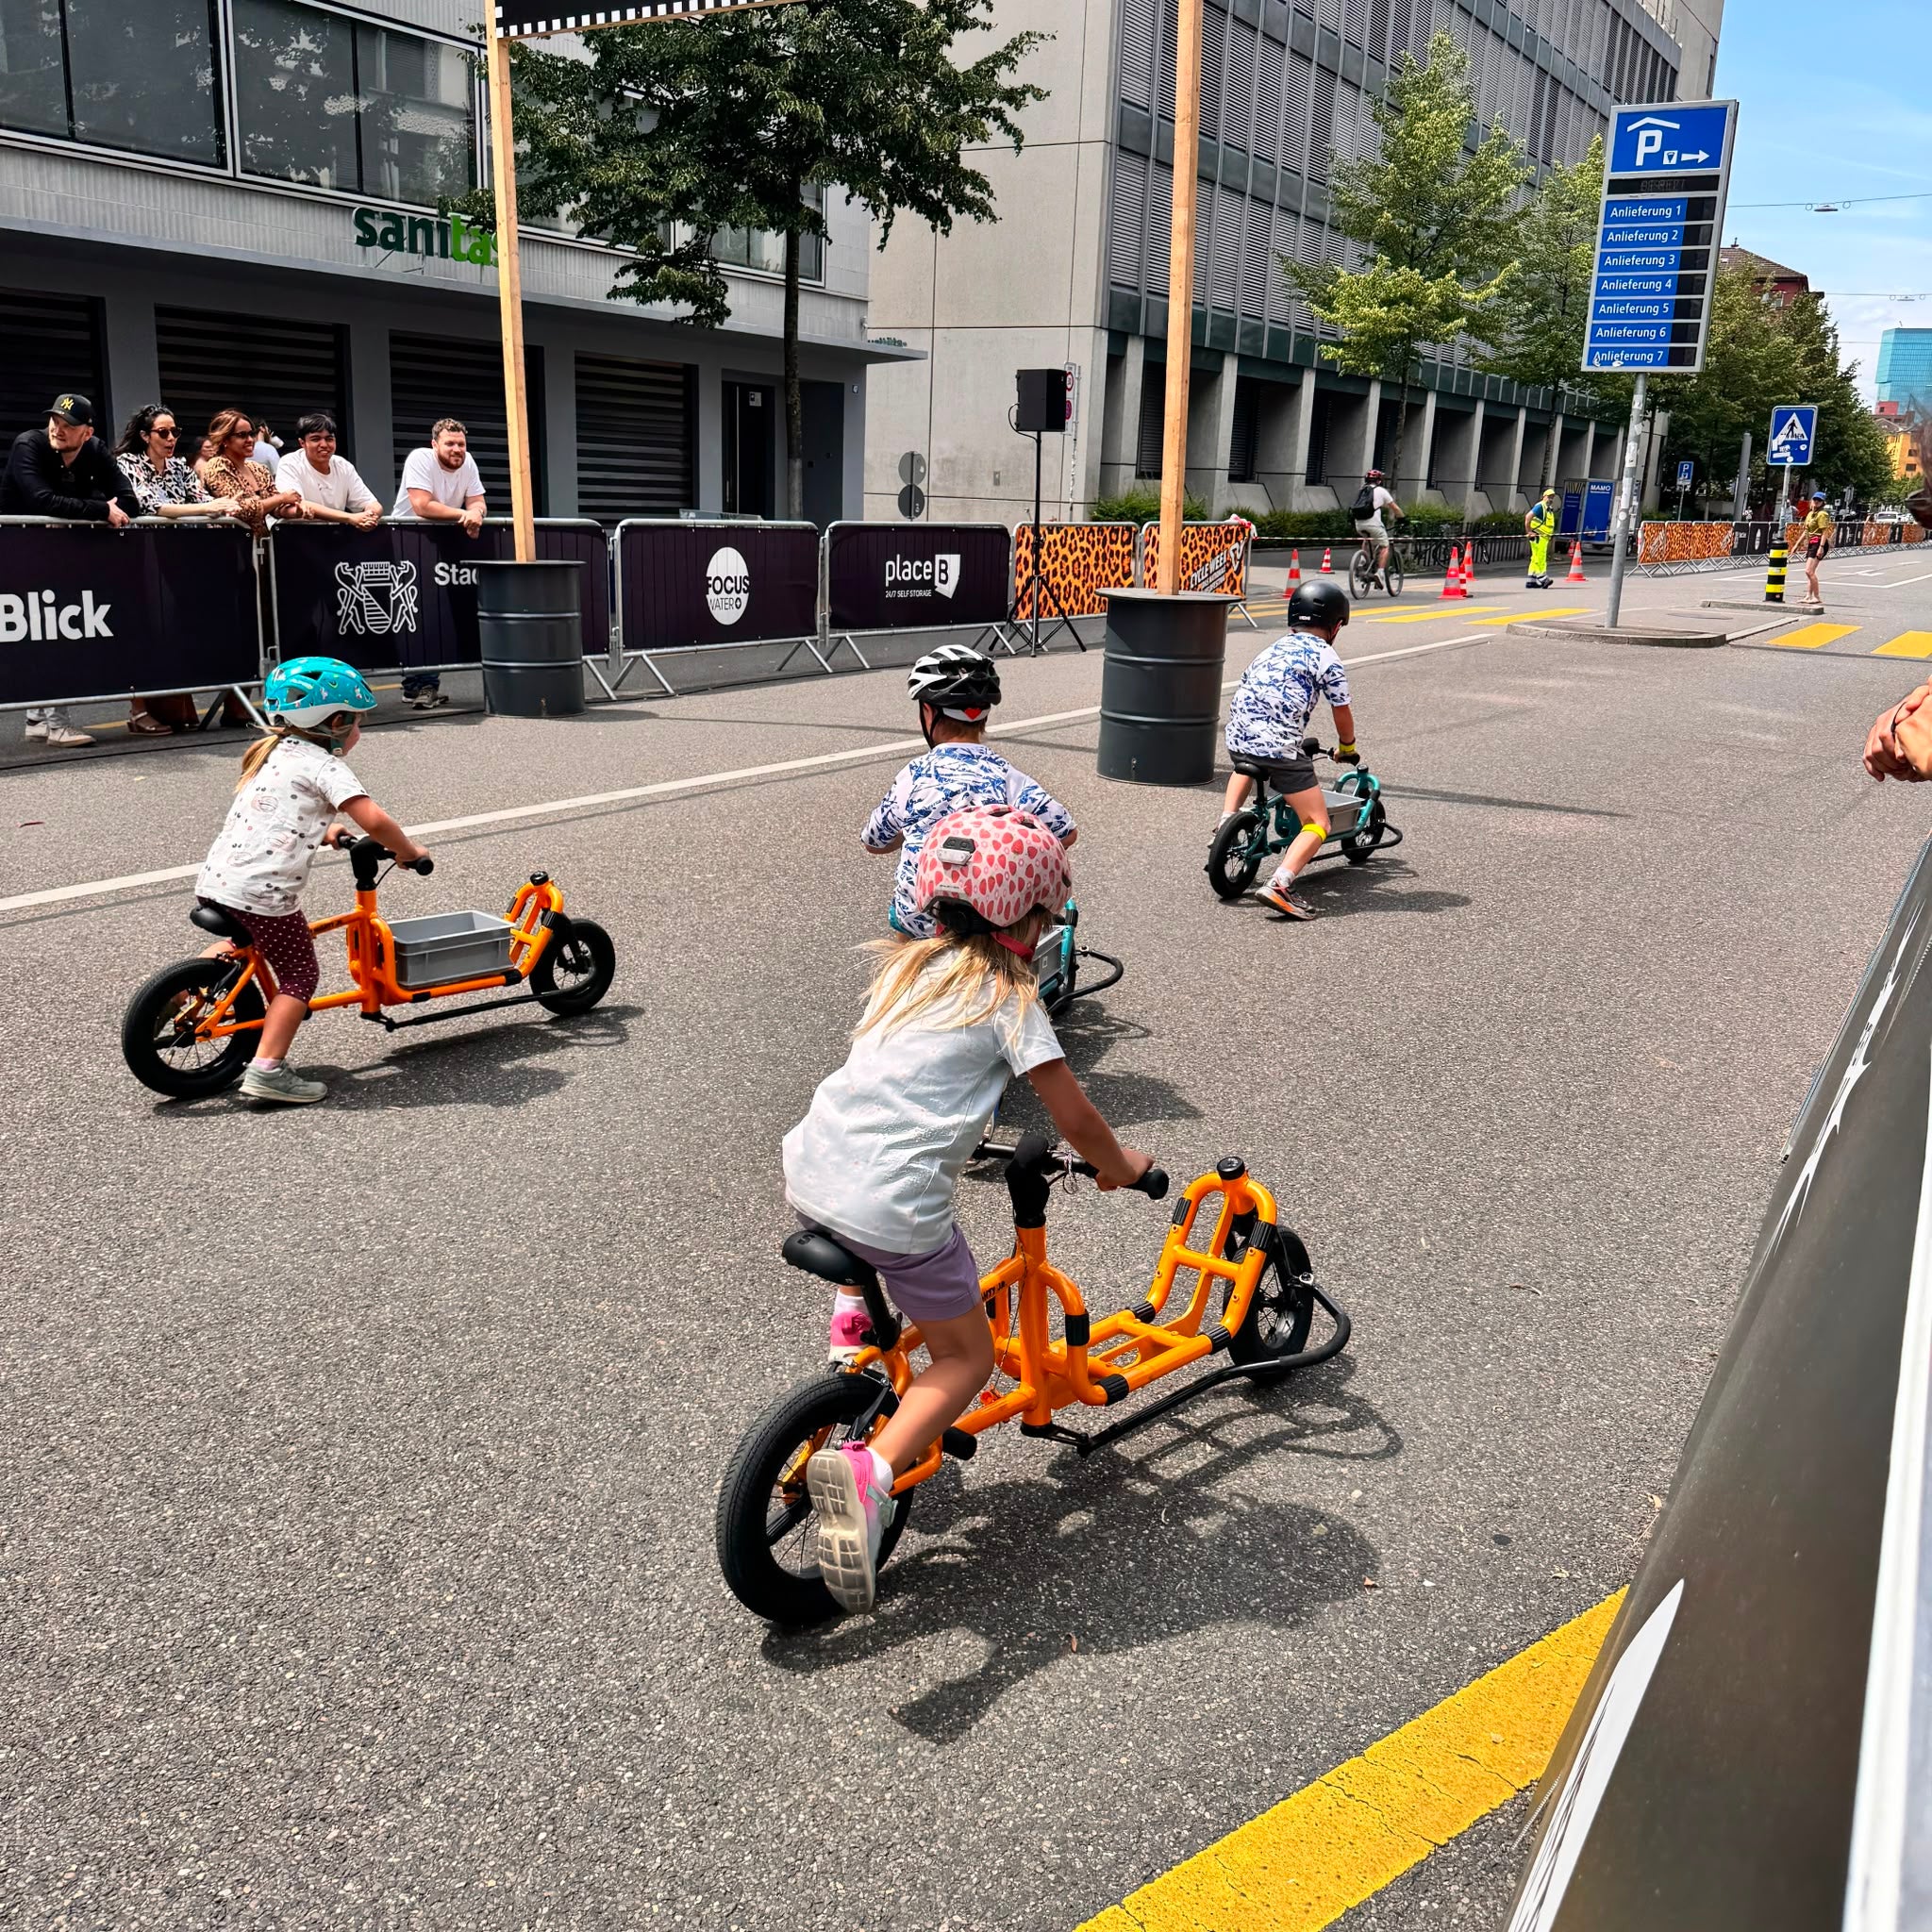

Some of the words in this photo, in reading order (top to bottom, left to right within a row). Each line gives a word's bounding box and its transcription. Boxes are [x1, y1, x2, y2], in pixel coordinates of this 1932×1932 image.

[1635, 129, 1663, 166] P
[1609, 206, 1673, 219] Anlieferung
[1675, 205, 1681, 216] 1
[1607, 230, 1669, 243] Anlieferung
[1671, 229, 1678, 241] 2
[1604, 255, 1666, 268] Anlieferung
[1668, 254, 1675, 265] 3
[1601, 279, 1662, 291] Anlieferung
[1665, 278, 1672, 289] 4
[1598, 303, 1659, 316] Anlieferung
[1662, 303, 1670, 313] 5
[1595, 327, 1657, 340] Anlieferung
[1658, 326, 1666, 338] 6
[1593, 351, 1654, 363] Anlieferung
[1657, 350, 1663, 360] 7
[706, 575, 750, 594] FOCUS
[909, 589, 932, 597] STORAGE
[0, 589, 114, 642] Blick
